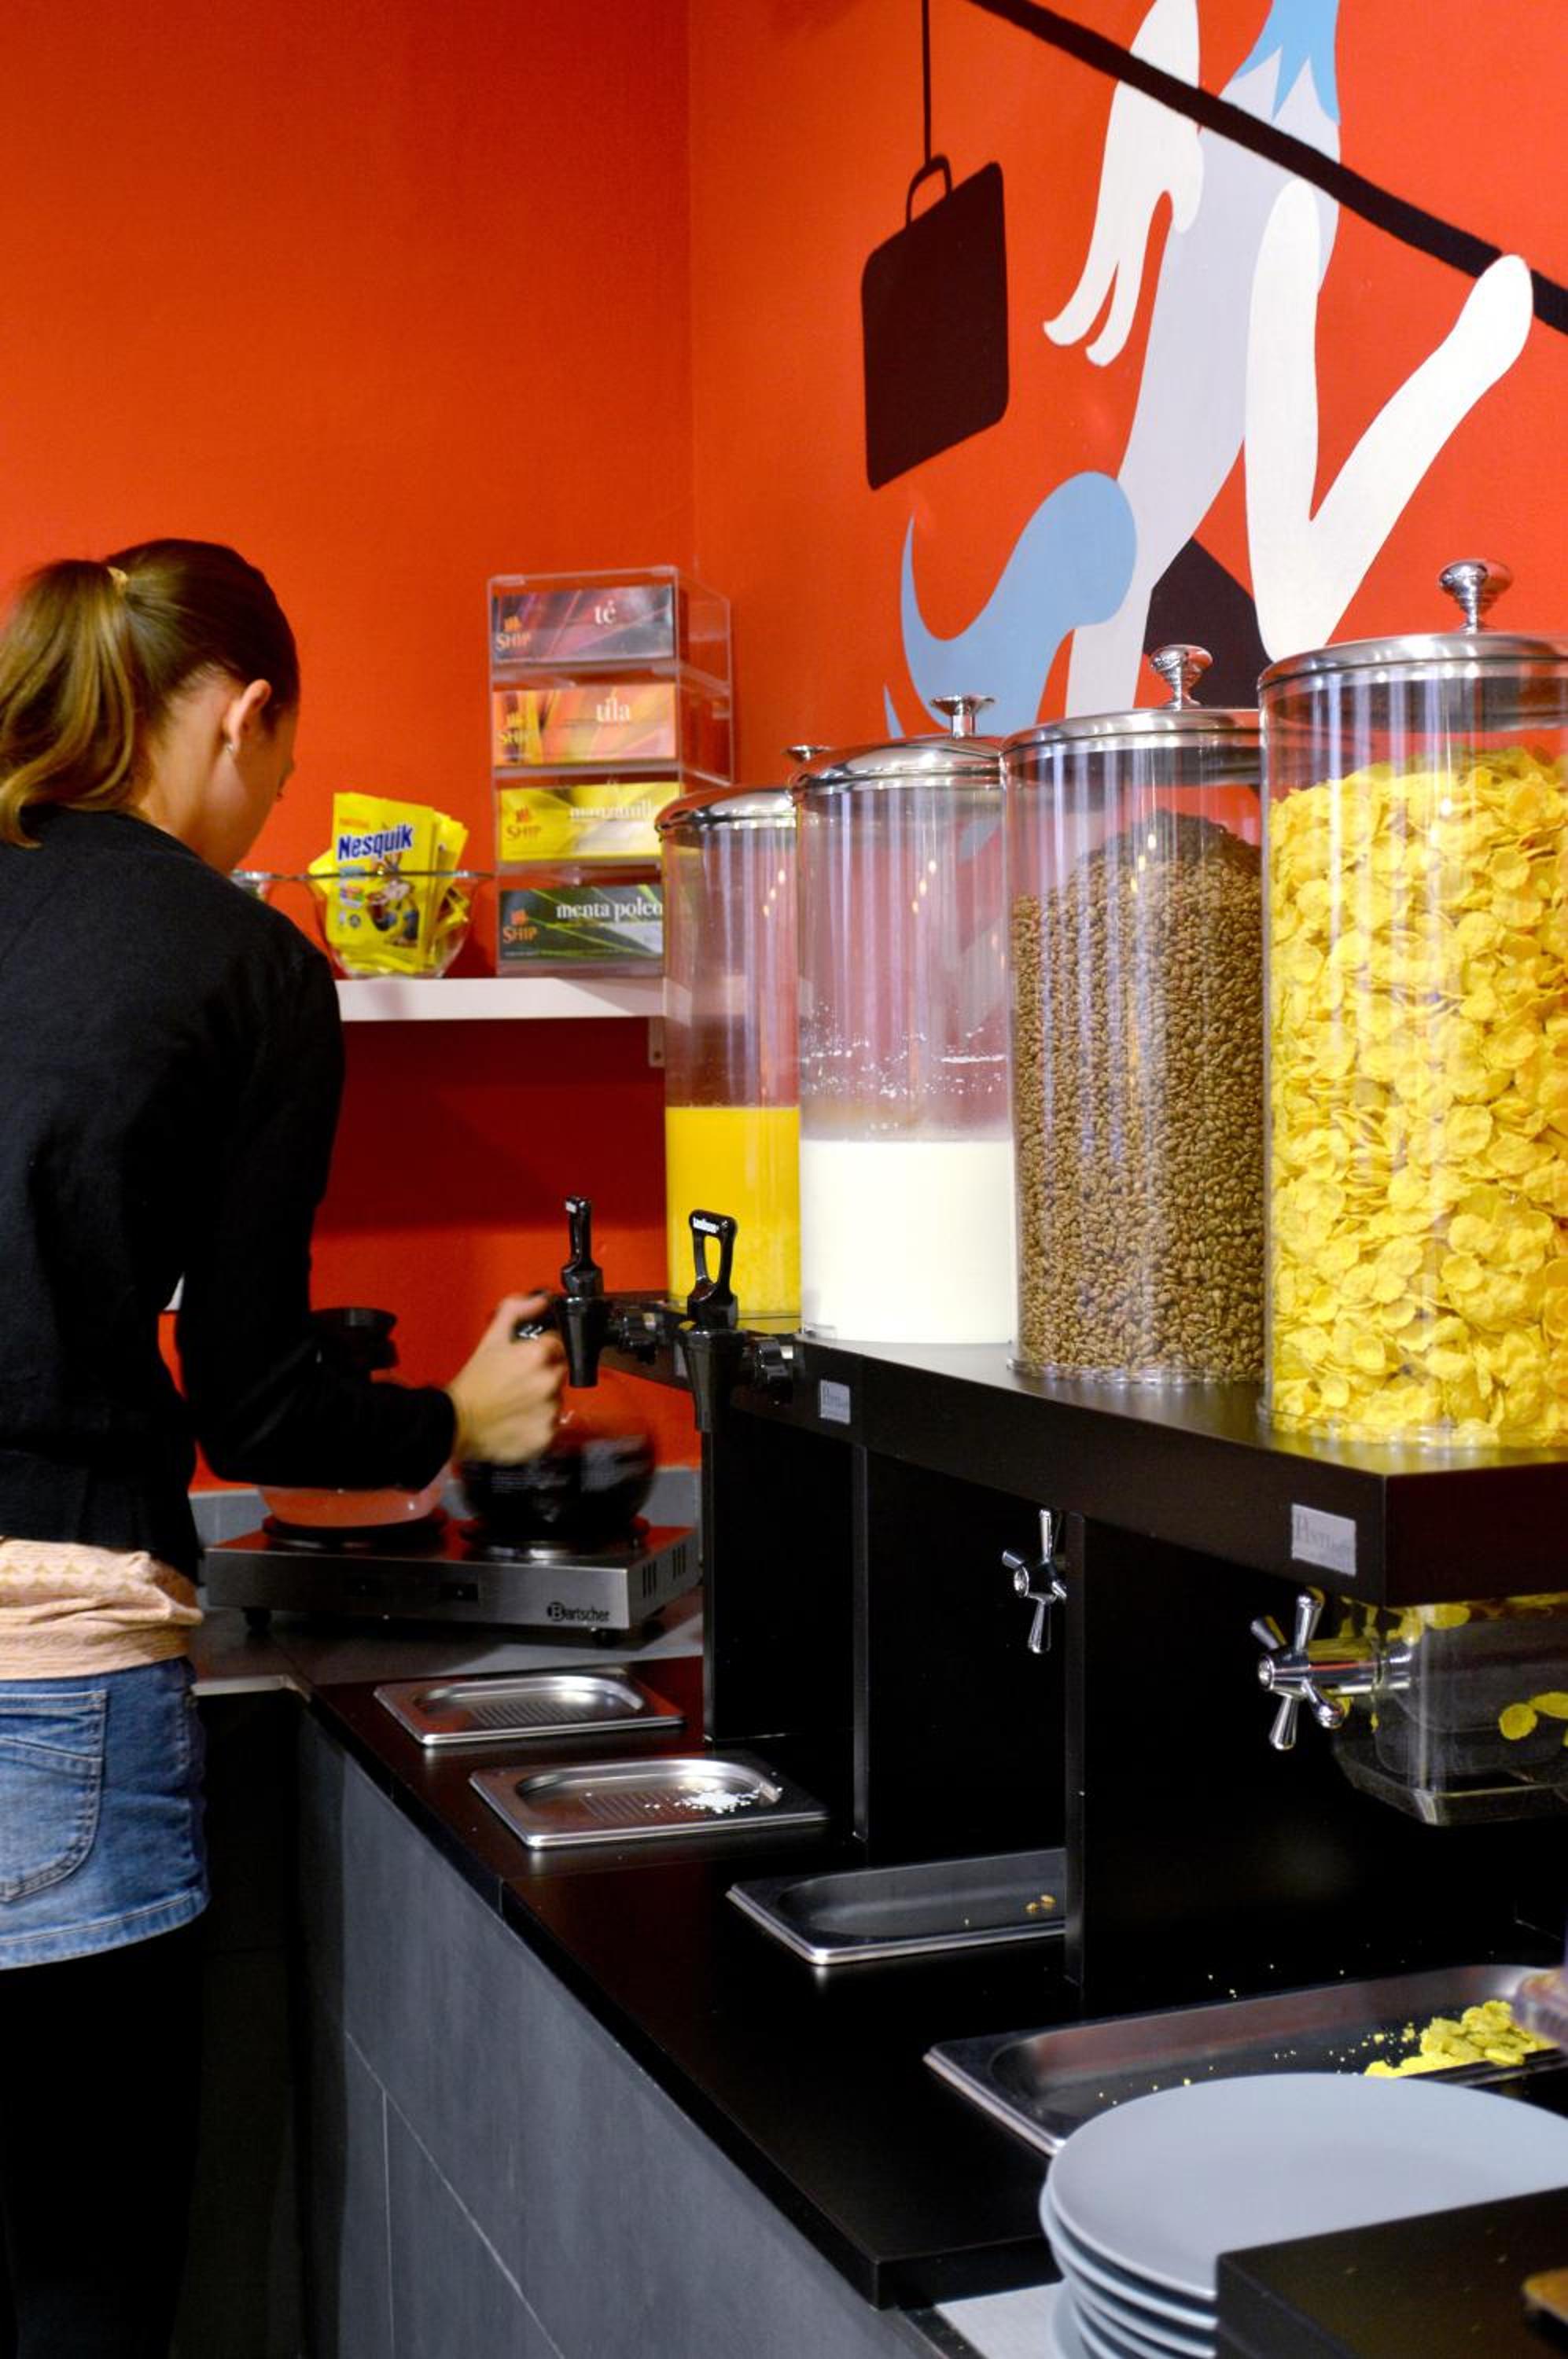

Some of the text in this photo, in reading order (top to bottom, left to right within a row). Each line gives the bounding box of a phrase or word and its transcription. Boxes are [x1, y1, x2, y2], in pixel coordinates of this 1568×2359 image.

[337, 823, 413, 861] Nesquik
[556, 896, 663, 922] menta poleo
[547, 1601, 609, 1622] Bartscher
